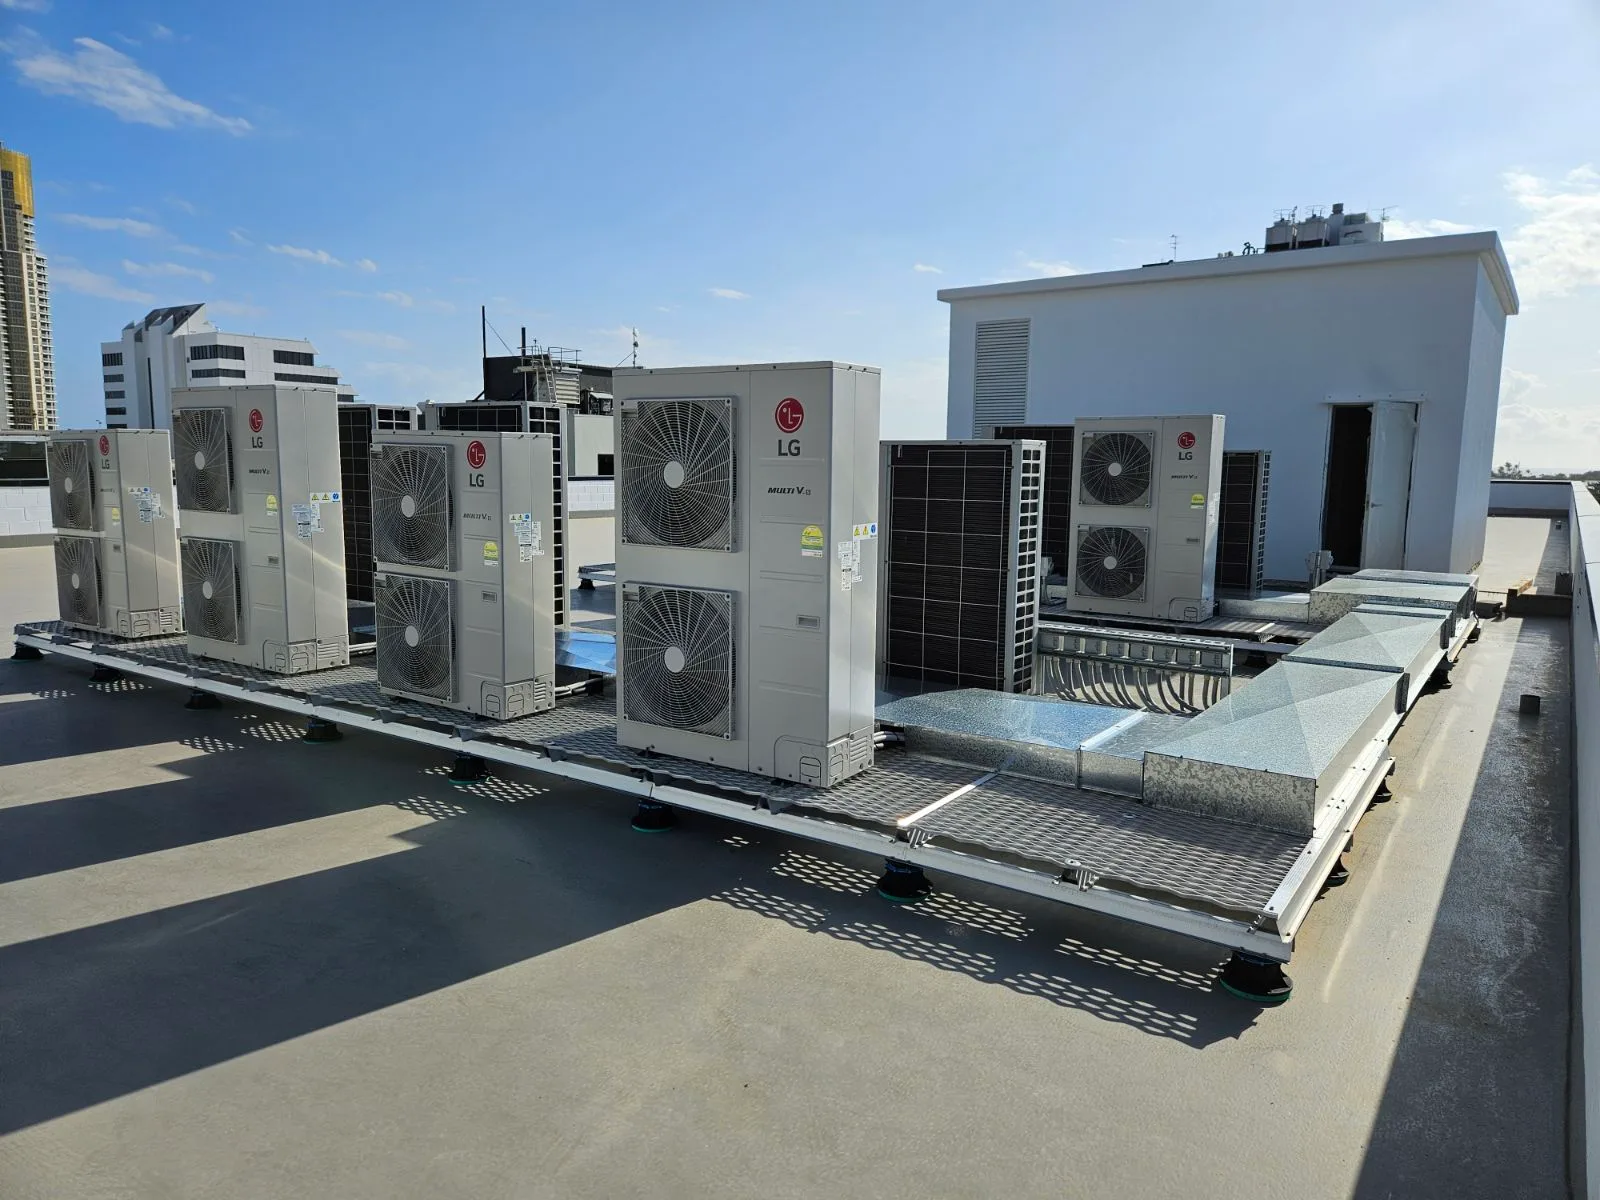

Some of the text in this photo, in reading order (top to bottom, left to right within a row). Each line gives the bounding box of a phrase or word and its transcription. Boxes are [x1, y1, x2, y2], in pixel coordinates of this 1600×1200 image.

[252, 437, 263, 448] LG
[778, 439, 801, 456] LG
[1178, 452, 1193, 460] LG
[102, 459, 110, 469] LG
[469, 473, 484, 487] LG
